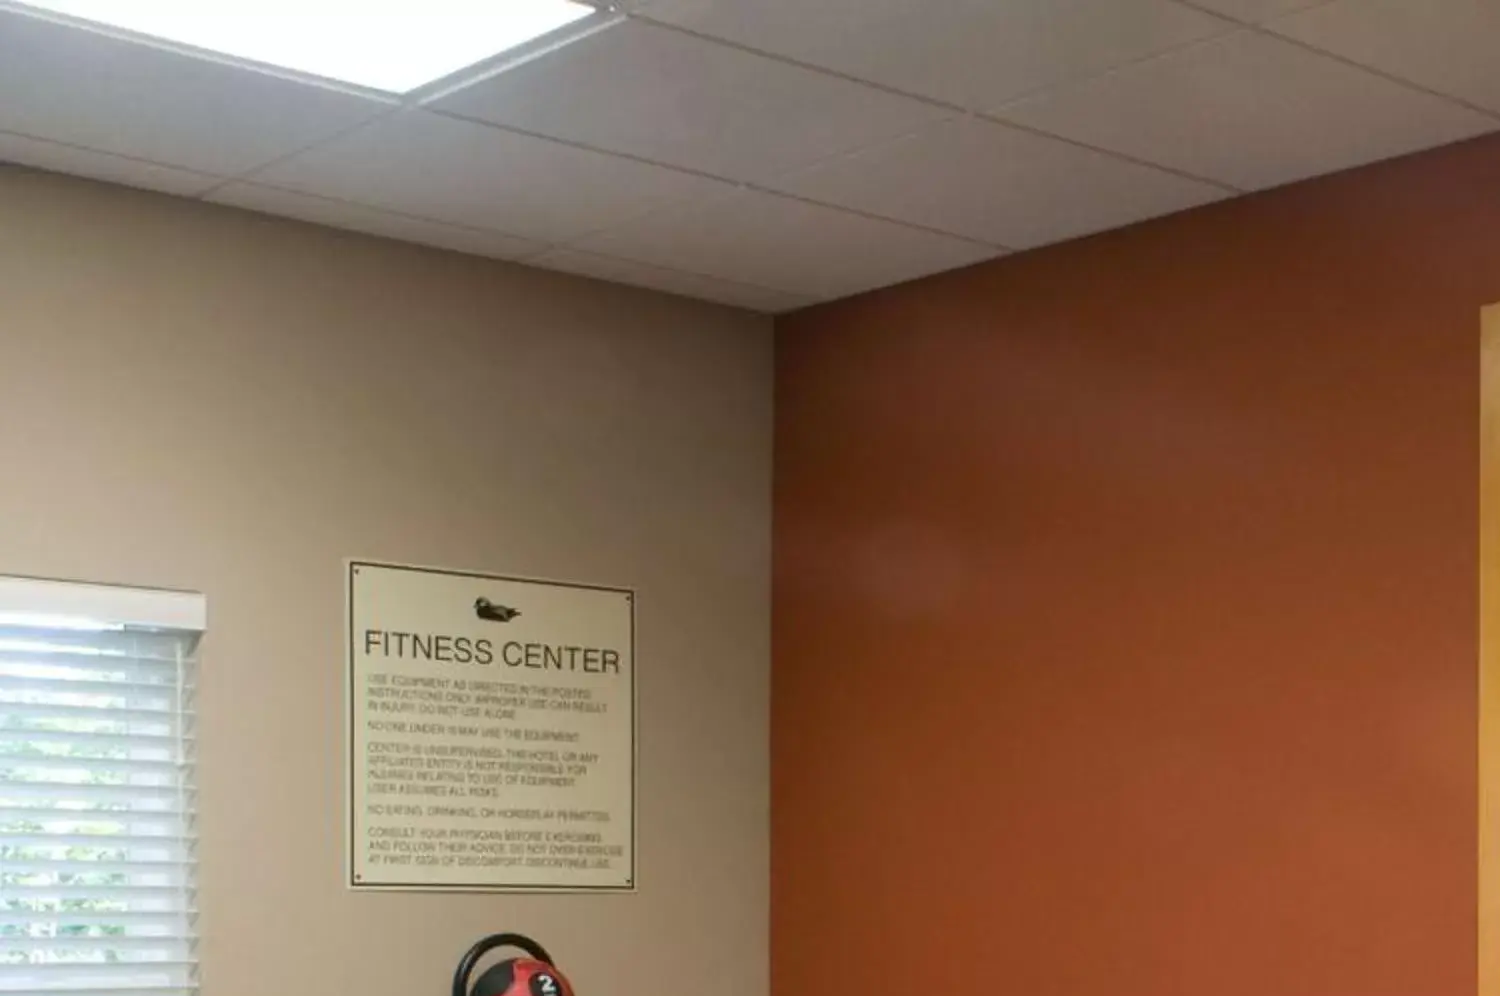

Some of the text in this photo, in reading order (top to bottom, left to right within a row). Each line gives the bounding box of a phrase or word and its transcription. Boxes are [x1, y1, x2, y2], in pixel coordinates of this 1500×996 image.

[365, 630, 620, 673] FITNESS CENTER
[537, 975, 557, 993] 2
